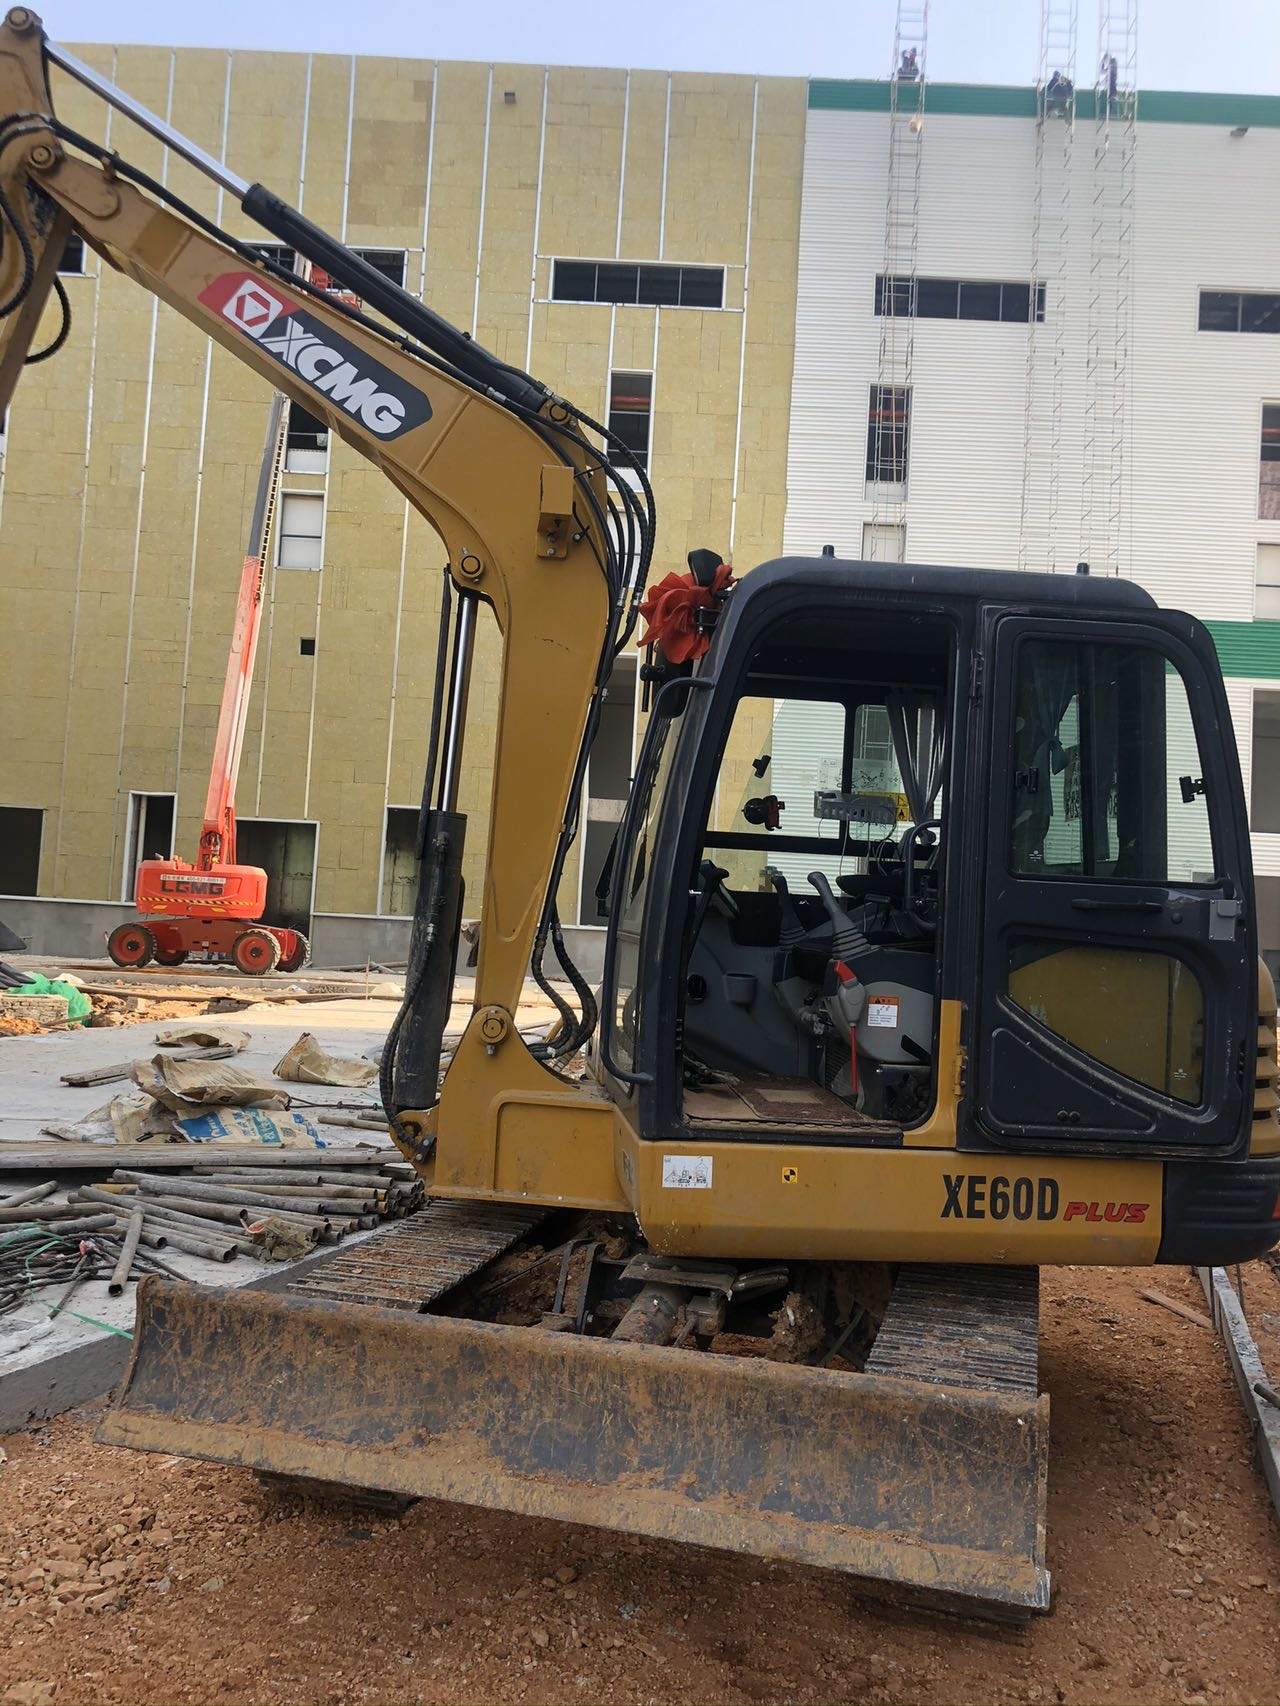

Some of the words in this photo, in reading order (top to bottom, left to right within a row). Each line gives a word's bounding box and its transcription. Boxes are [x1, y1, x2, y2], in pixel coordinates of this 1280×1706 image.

[258, 316, 406, 434] XCMG
[940, 1174, 1060, 1221] XE60D
[1062, 1201, 1150, 1224] PLUS
